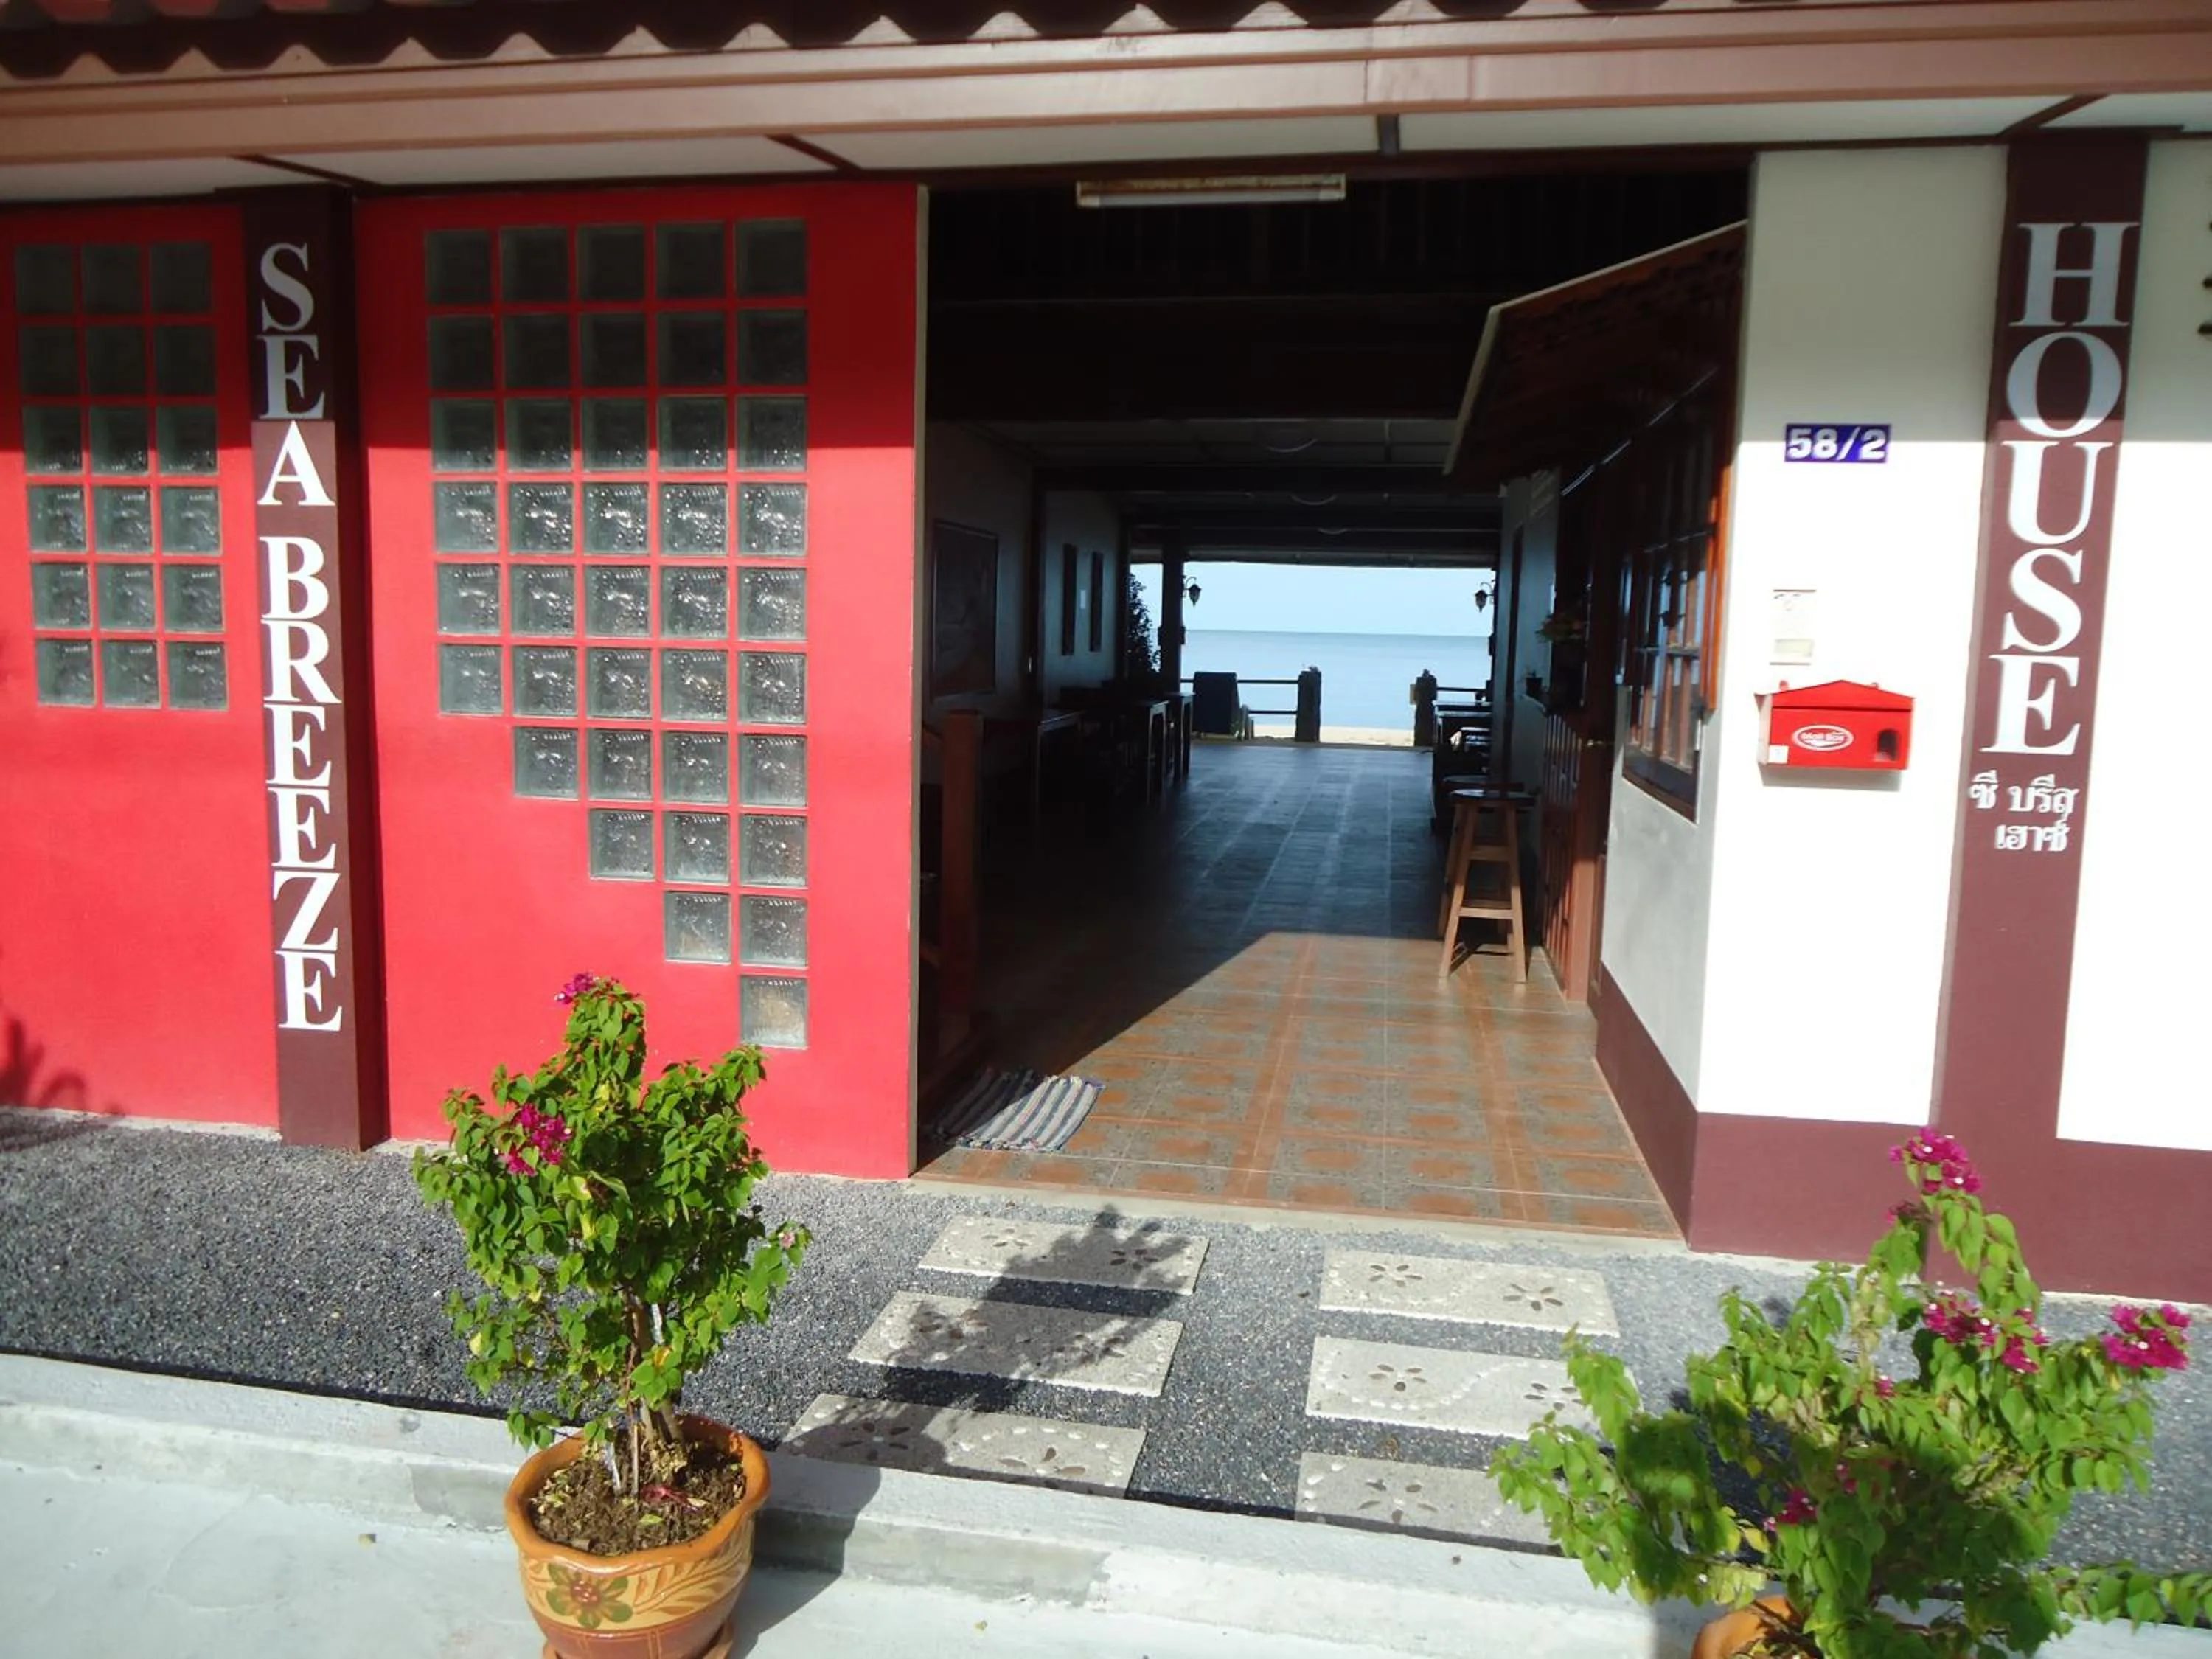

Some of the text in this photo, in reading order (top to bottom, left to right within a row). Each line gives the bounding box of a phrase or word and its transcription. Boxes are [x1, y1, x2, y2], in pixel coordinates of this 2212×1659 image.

[255, 242, 343, 1032] SEA BREEZE
[1787, 426, 1887, 461] 58/2
[1979, 222, 2141, 756] HOUSE
